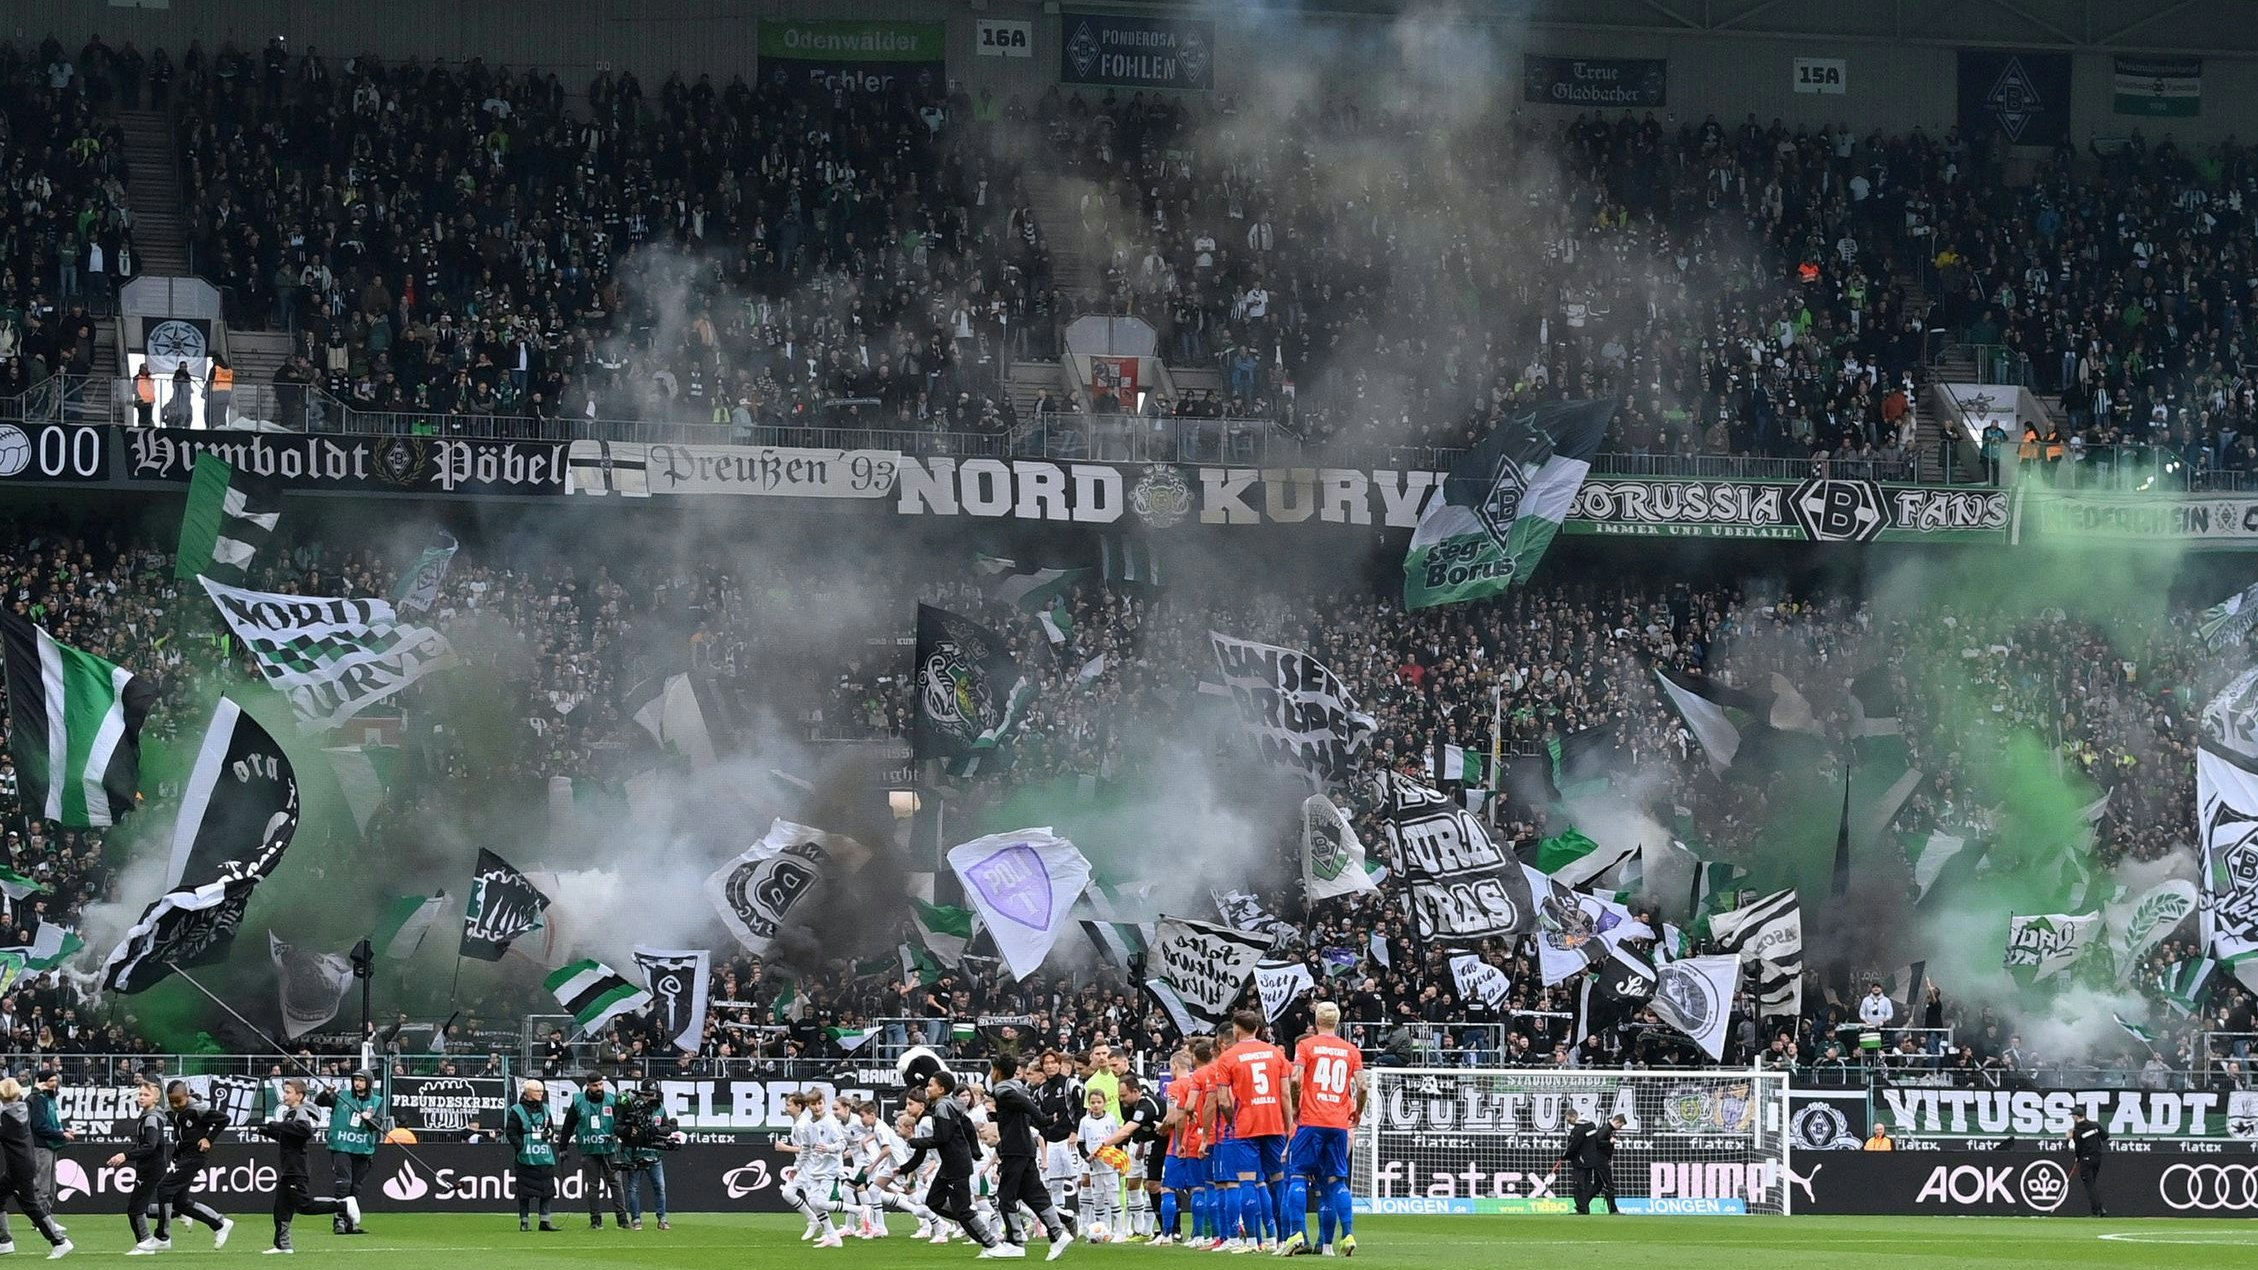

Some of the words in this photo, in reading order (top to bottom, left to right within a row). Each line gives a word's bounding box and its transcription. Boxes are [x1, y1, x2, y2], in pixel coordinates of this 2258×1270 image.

[783, 28, 919, 52] Odenwälder
[982, 29, 1027, 48] 16A
[1102, 29, 1176, 49] PONDEROSA
[1101, 53, 1176, 80] FOHLEN
[1573, 62, 1618, 81] Treue
[1800, 66, 1840, 84] 15A
[1552, 83, 1640, 102] Gladbacher
[39, 426, 100, 476] 00
[126, 426, 370, 479] Humboldt
[431, 439, 564, 490] Pöbel
[650, 446, 828, 491] Preußen
[898, 456, 1124, 523] NORD
[1200, 468, 1449, 528] KURV
[1895, 489, 2010, 532] FANS
[1595, 523, 1658, 535] IMMER
[1669, 525, 1702, 536] UND
[1711, 524, 1797, 538] ÜBERALL!
[1250, 1061, 1270, 1095] 5
[1313, 1057, 1348, 1094] 40
[391, 1093, 506, 1110] FREUNDESKREIS
[1884, 1089, 2218, 1134] VITUSSTADT
[689, 1132, 736, 1144] flatex
[1613, 1137, 1655, 1150] atex
[1689, 1137, 1745, 1150] flatex
[2108, 1141, 2151, 1152] flatex
[2179, 1141, 2222, 1152] flatex
[97, 1158, 278, 1193] reer.de
[1377, 1161, 1558, 1198] flatex
[1650, 1163, 1768, 1203] PUMA
[1915, 1165, 2016, 1204] AOK
[1376, 1200, 1450, 1214] JONGEN
[1647, 1200, 1720, 1214] JONGEN
